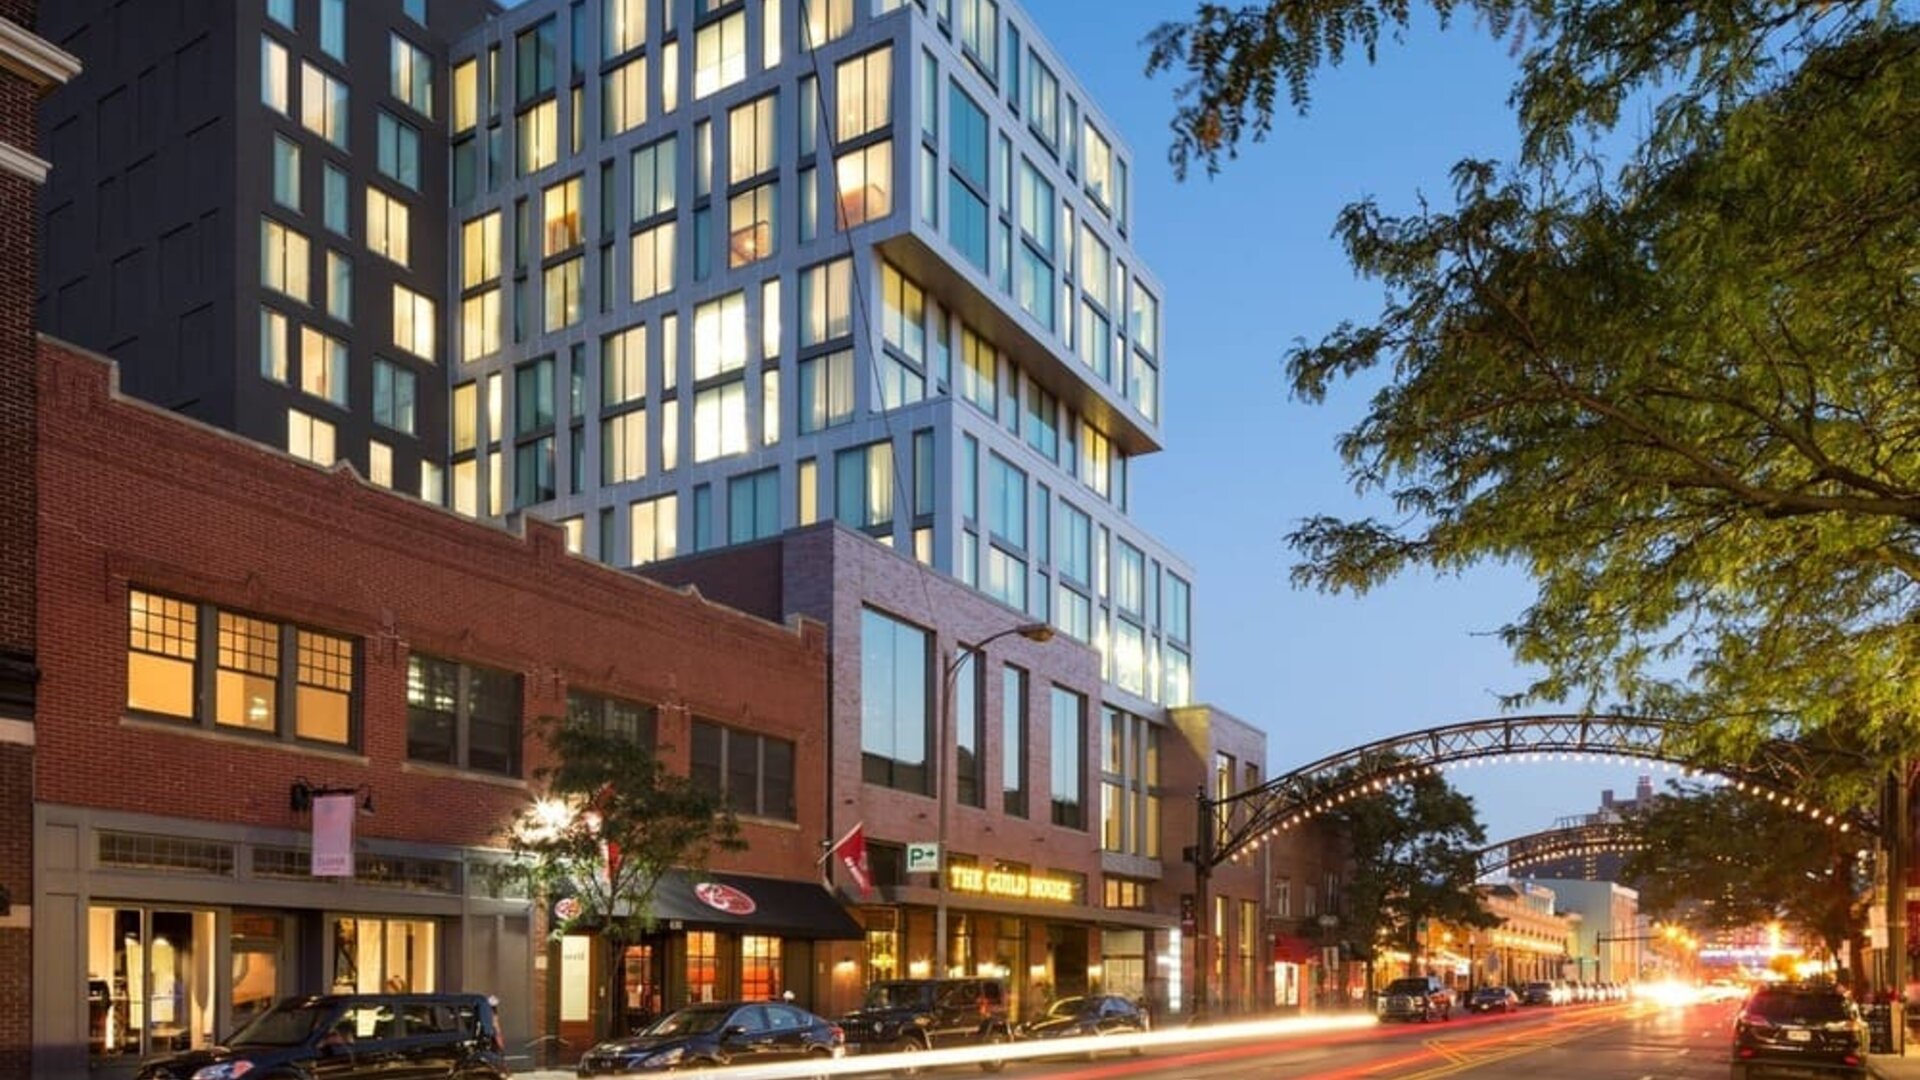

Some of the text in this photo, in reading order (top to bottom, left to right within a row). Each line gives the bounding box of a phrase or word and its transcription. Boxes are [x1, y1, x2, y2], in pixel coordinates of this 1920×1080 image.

[910, 848, 924, 867] P
[951, 865, 1073, 902] THE GUILD HOUSE
